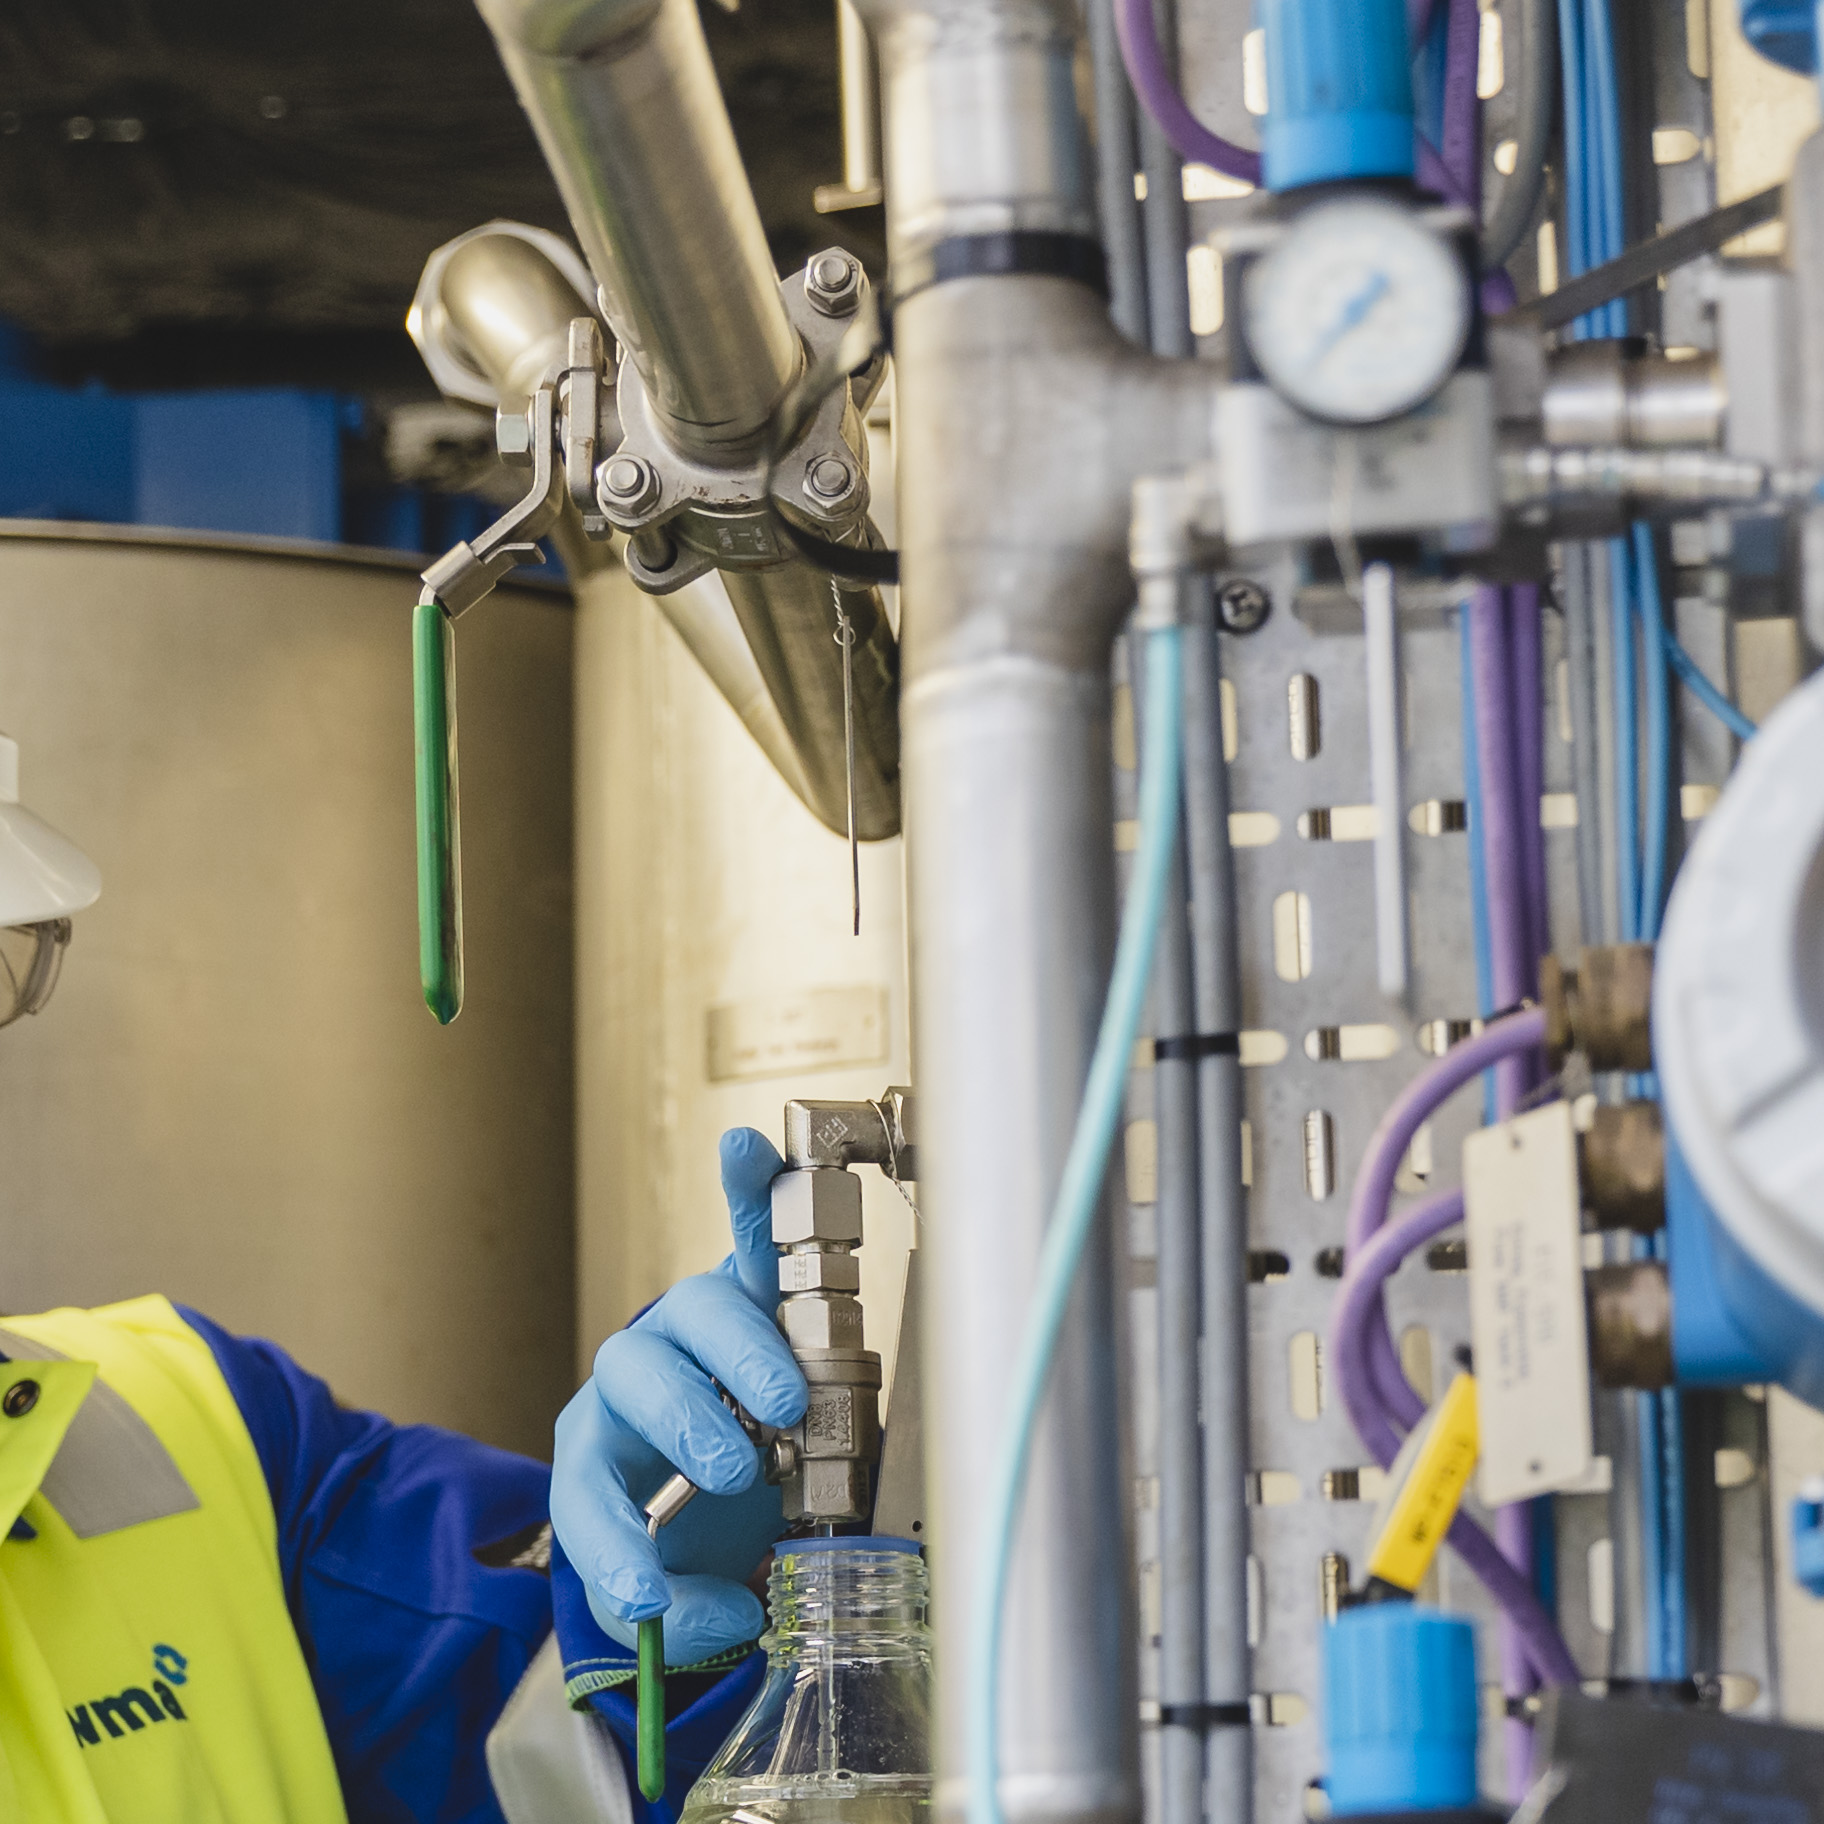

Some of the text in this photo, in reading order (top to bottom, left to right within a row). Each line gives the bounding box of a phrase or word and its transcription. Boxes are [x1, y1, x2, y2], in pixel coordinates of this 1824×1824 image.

[808, 1404, 822, 1436] DN8
[822, 1400, 836, 1440] PN63
[66, 1680, 187, 1749] wma
